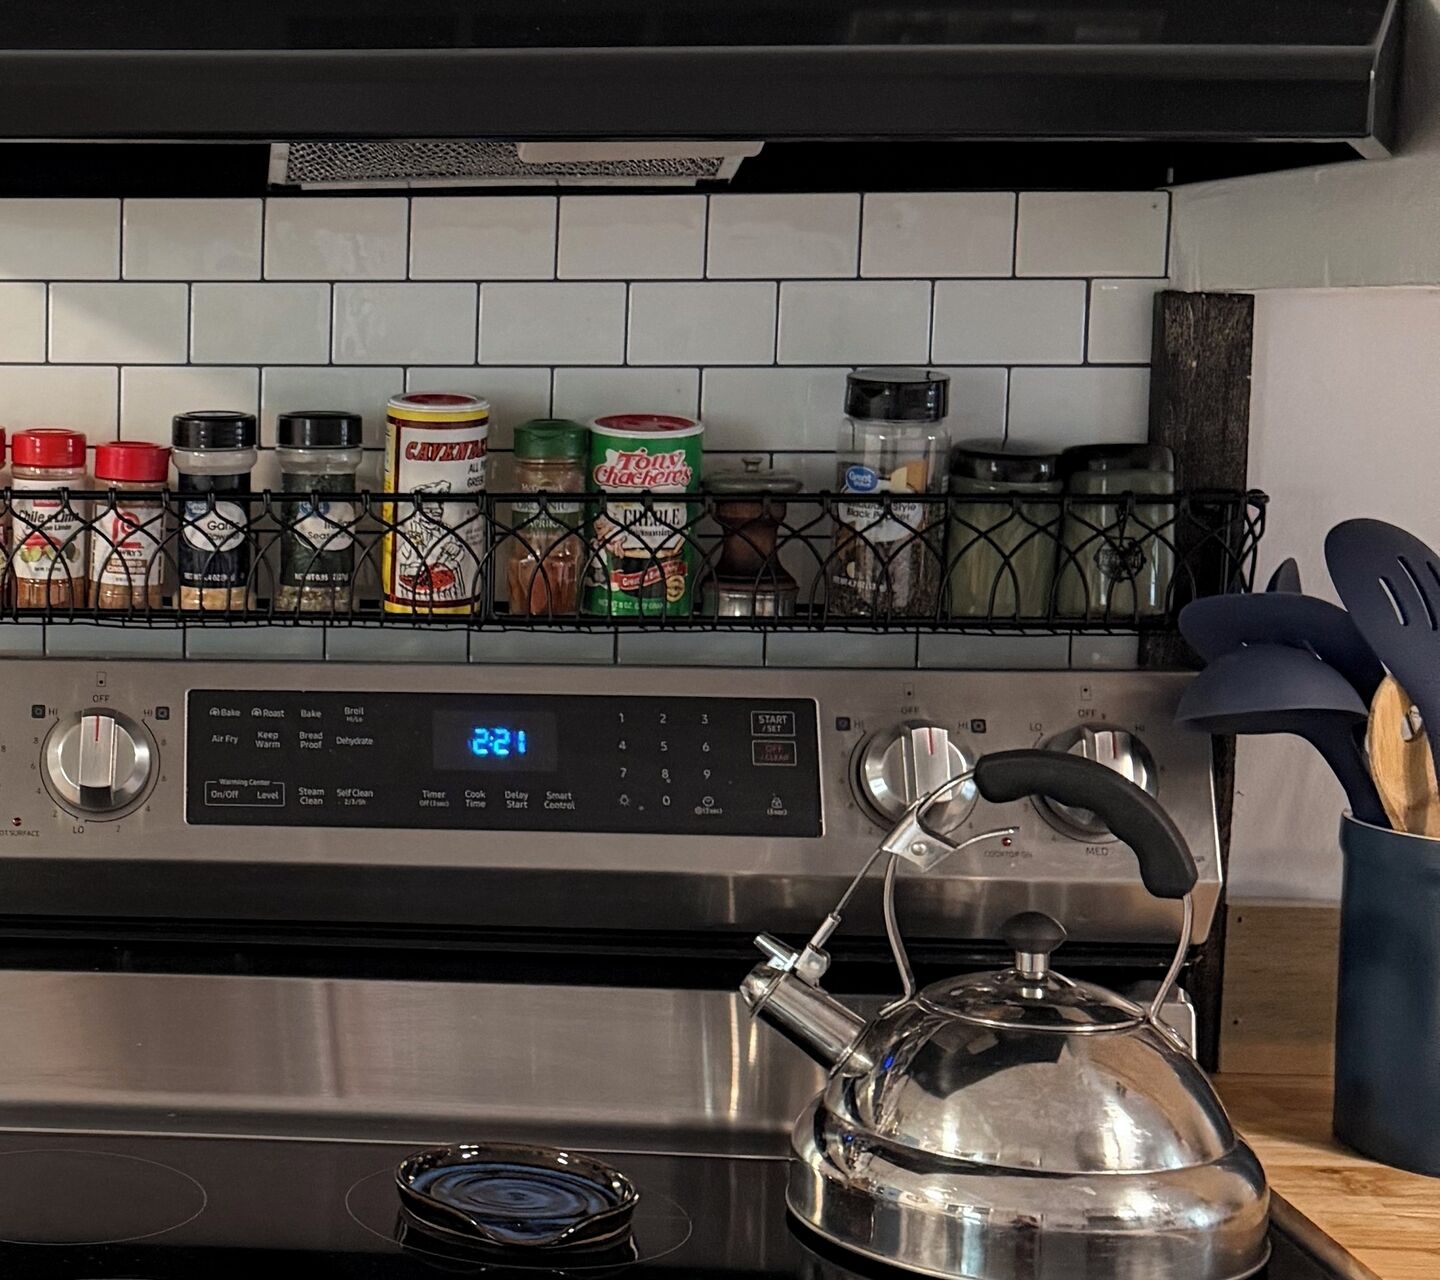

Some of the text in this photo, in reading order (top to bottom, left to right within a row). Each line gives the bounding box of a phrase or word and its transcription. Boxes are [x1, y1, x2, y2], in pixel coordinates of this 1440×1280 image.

[92, 695, 110, 704] OFF
[48, 708, 59, 716] HI
[220, 708, 241, 717] Bake
[262, 708, 285, 718] Roast
[300, 709, 322, 718] Bake
[344, 706, 364, 715] Broil
[900, 706, 919, 715] OFF
[1077, 709, 1096, 718] OFF
[660, 713, 667, 724] 2
[701, 714, 709, 724] 3
[758, 714, 787, 725] START
[1029, 722, 1042, 732] LO
[211, 734, 239, 745] Air Fry
[257, 731, 279, 741] Keep
[299, 731, 323, 740] Bread
[255, 740, 281, 749] Warm
[300, 740, 323, 749] Proof
[336, 736, 374, 746] Dehydrate
[619, 740, 626, 750] 4
[660, 741, 668, 751] 5
[702, 742, 710, 752] 6
[620, 767, 627, 778] 7
[661, 768, 669, 779] 8
[703, 769, 711, 780] 9
[210, 790, 239, 799] On/Off
[257, 790, 279, 800] Level
[298, 787, 325, 796] Steam
[336, 788, 374, 798] Self Clean
[422, 790, 446, 799] Timer
[464, 789, 486, 799] Cook
[504, 790, 529, 801] Delay
[546, 791, 572, 800] Smart
[300, 797, 323, 806] Clean
[465, 799, 487, 808] Time
[506, 800, 528, 809] Start
[543, 800, 576, 810] Control
[662, 795, 671, 806] 0
[72, 825, 85, 835] LO
[1085, 847, 1109, 857] MED
